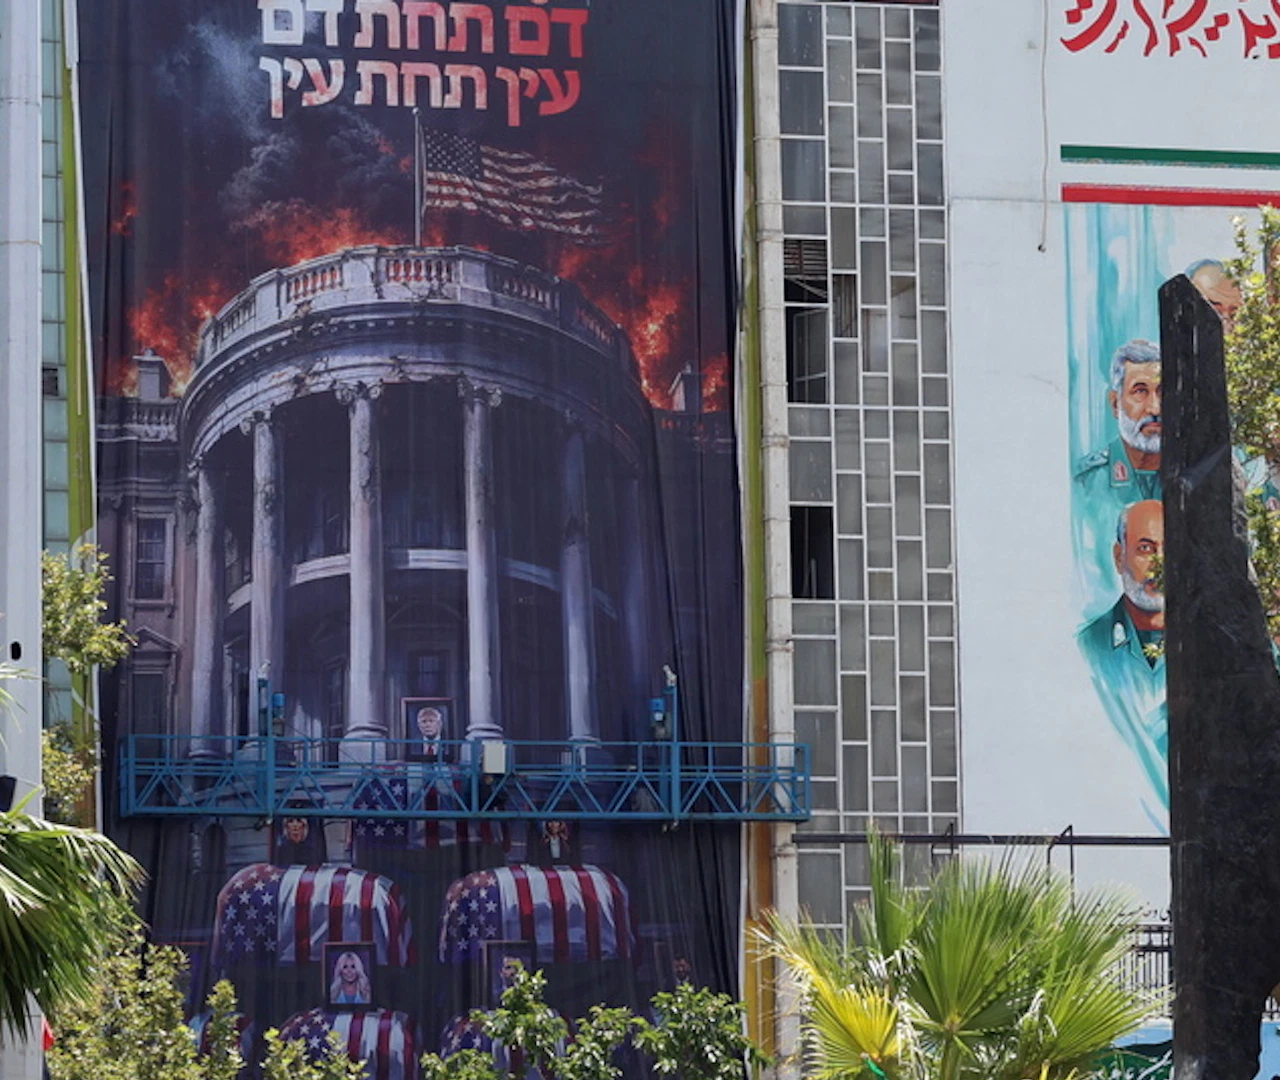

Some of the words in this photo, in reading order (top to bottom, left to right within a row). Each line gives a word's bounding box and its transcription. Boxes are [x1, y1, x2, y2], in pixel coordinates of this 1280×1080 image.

[257, 0, 345, 46] דם
[354, 0, 494, 54] תחת
[504, 5, 589, 58] דם
[259, 56, 346, 119] עין
[354, 60, 488, 110] תחת
[495, 66, 581, 127] עין
